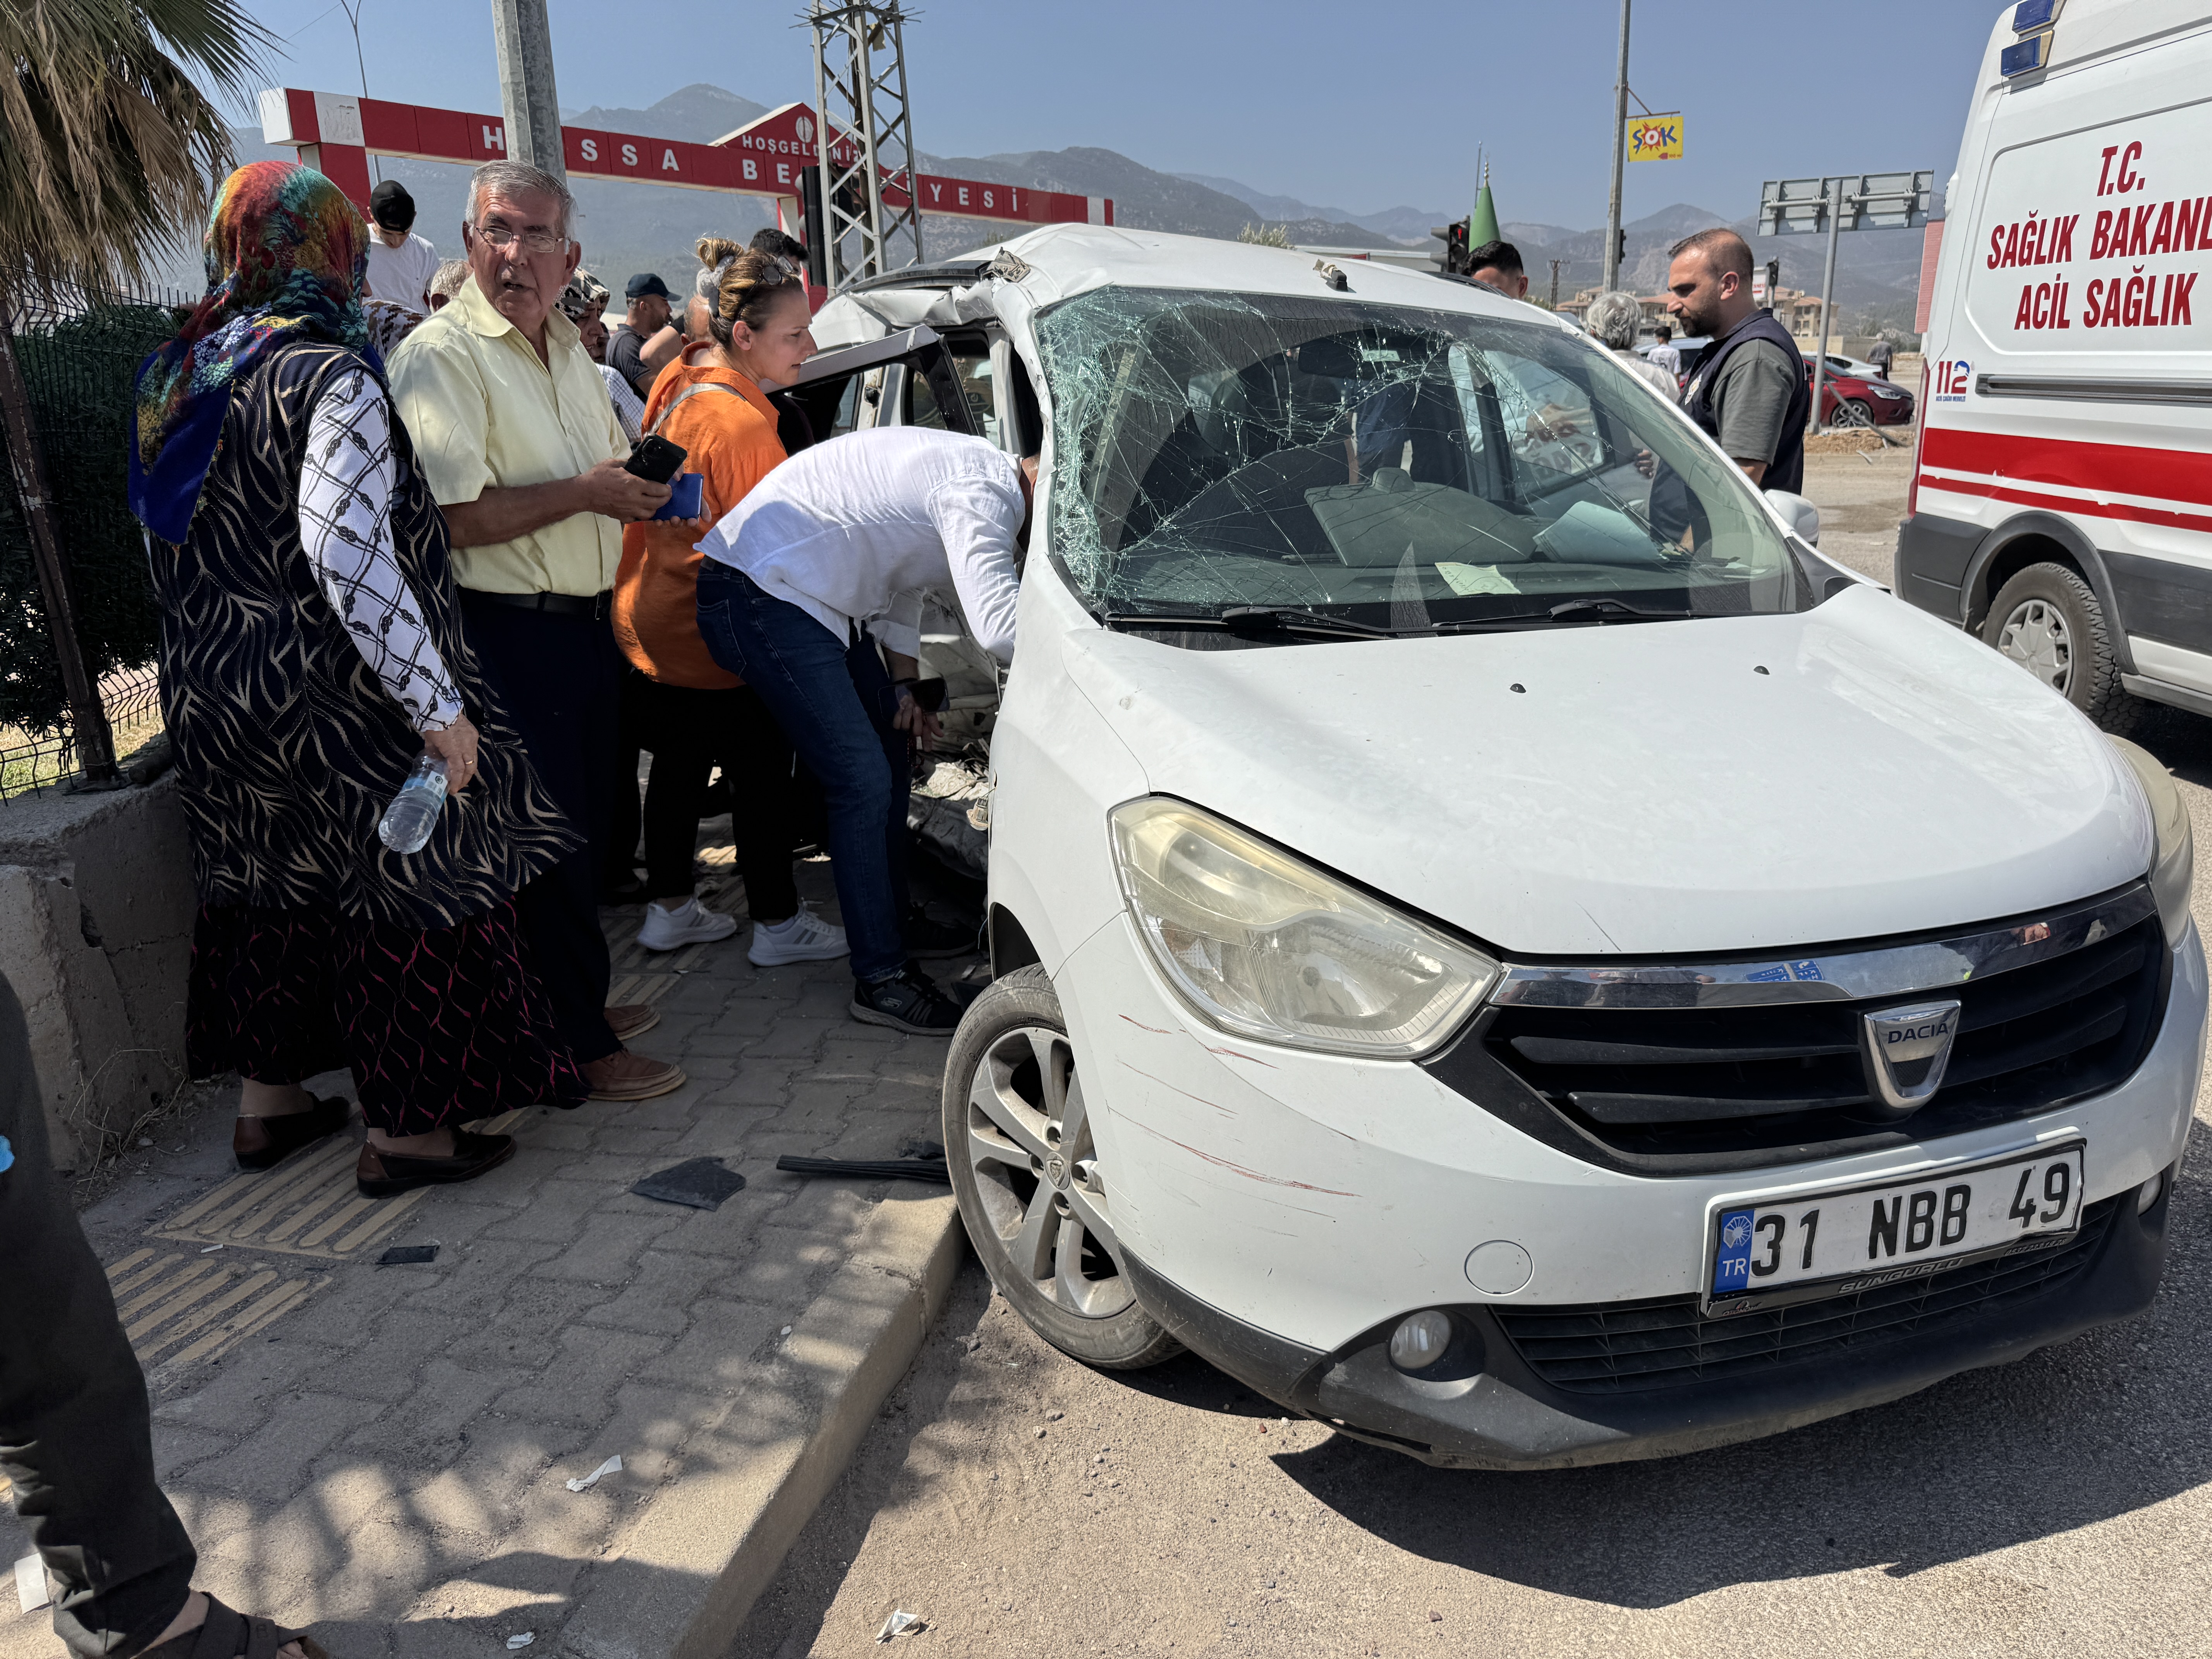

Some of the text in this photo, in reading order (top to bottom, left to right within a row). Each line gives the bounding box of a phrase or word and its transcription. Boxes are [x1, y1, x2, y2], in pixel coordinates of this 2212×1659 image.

[1632, 125, 1678, 155] ŞOK
[483, 125, 1018, 212] HSSA BEİYESİ
[2097, 141, 2145, 196] T.C.
[1987, 209, 2080, 270] SAĞLIK
[2014, 264, 2198, 330] ACİL SAĞLIK
[1936, 360, 1970, 394] 112
[1888, 1023, 1948, 1044] DACIA
[1751, 1162, 2069, 1276] 31 NBB 49
[1723, 1258, 1747, 1277] TR
[1839, 1258, 1964, 1293] SUNGURLU
